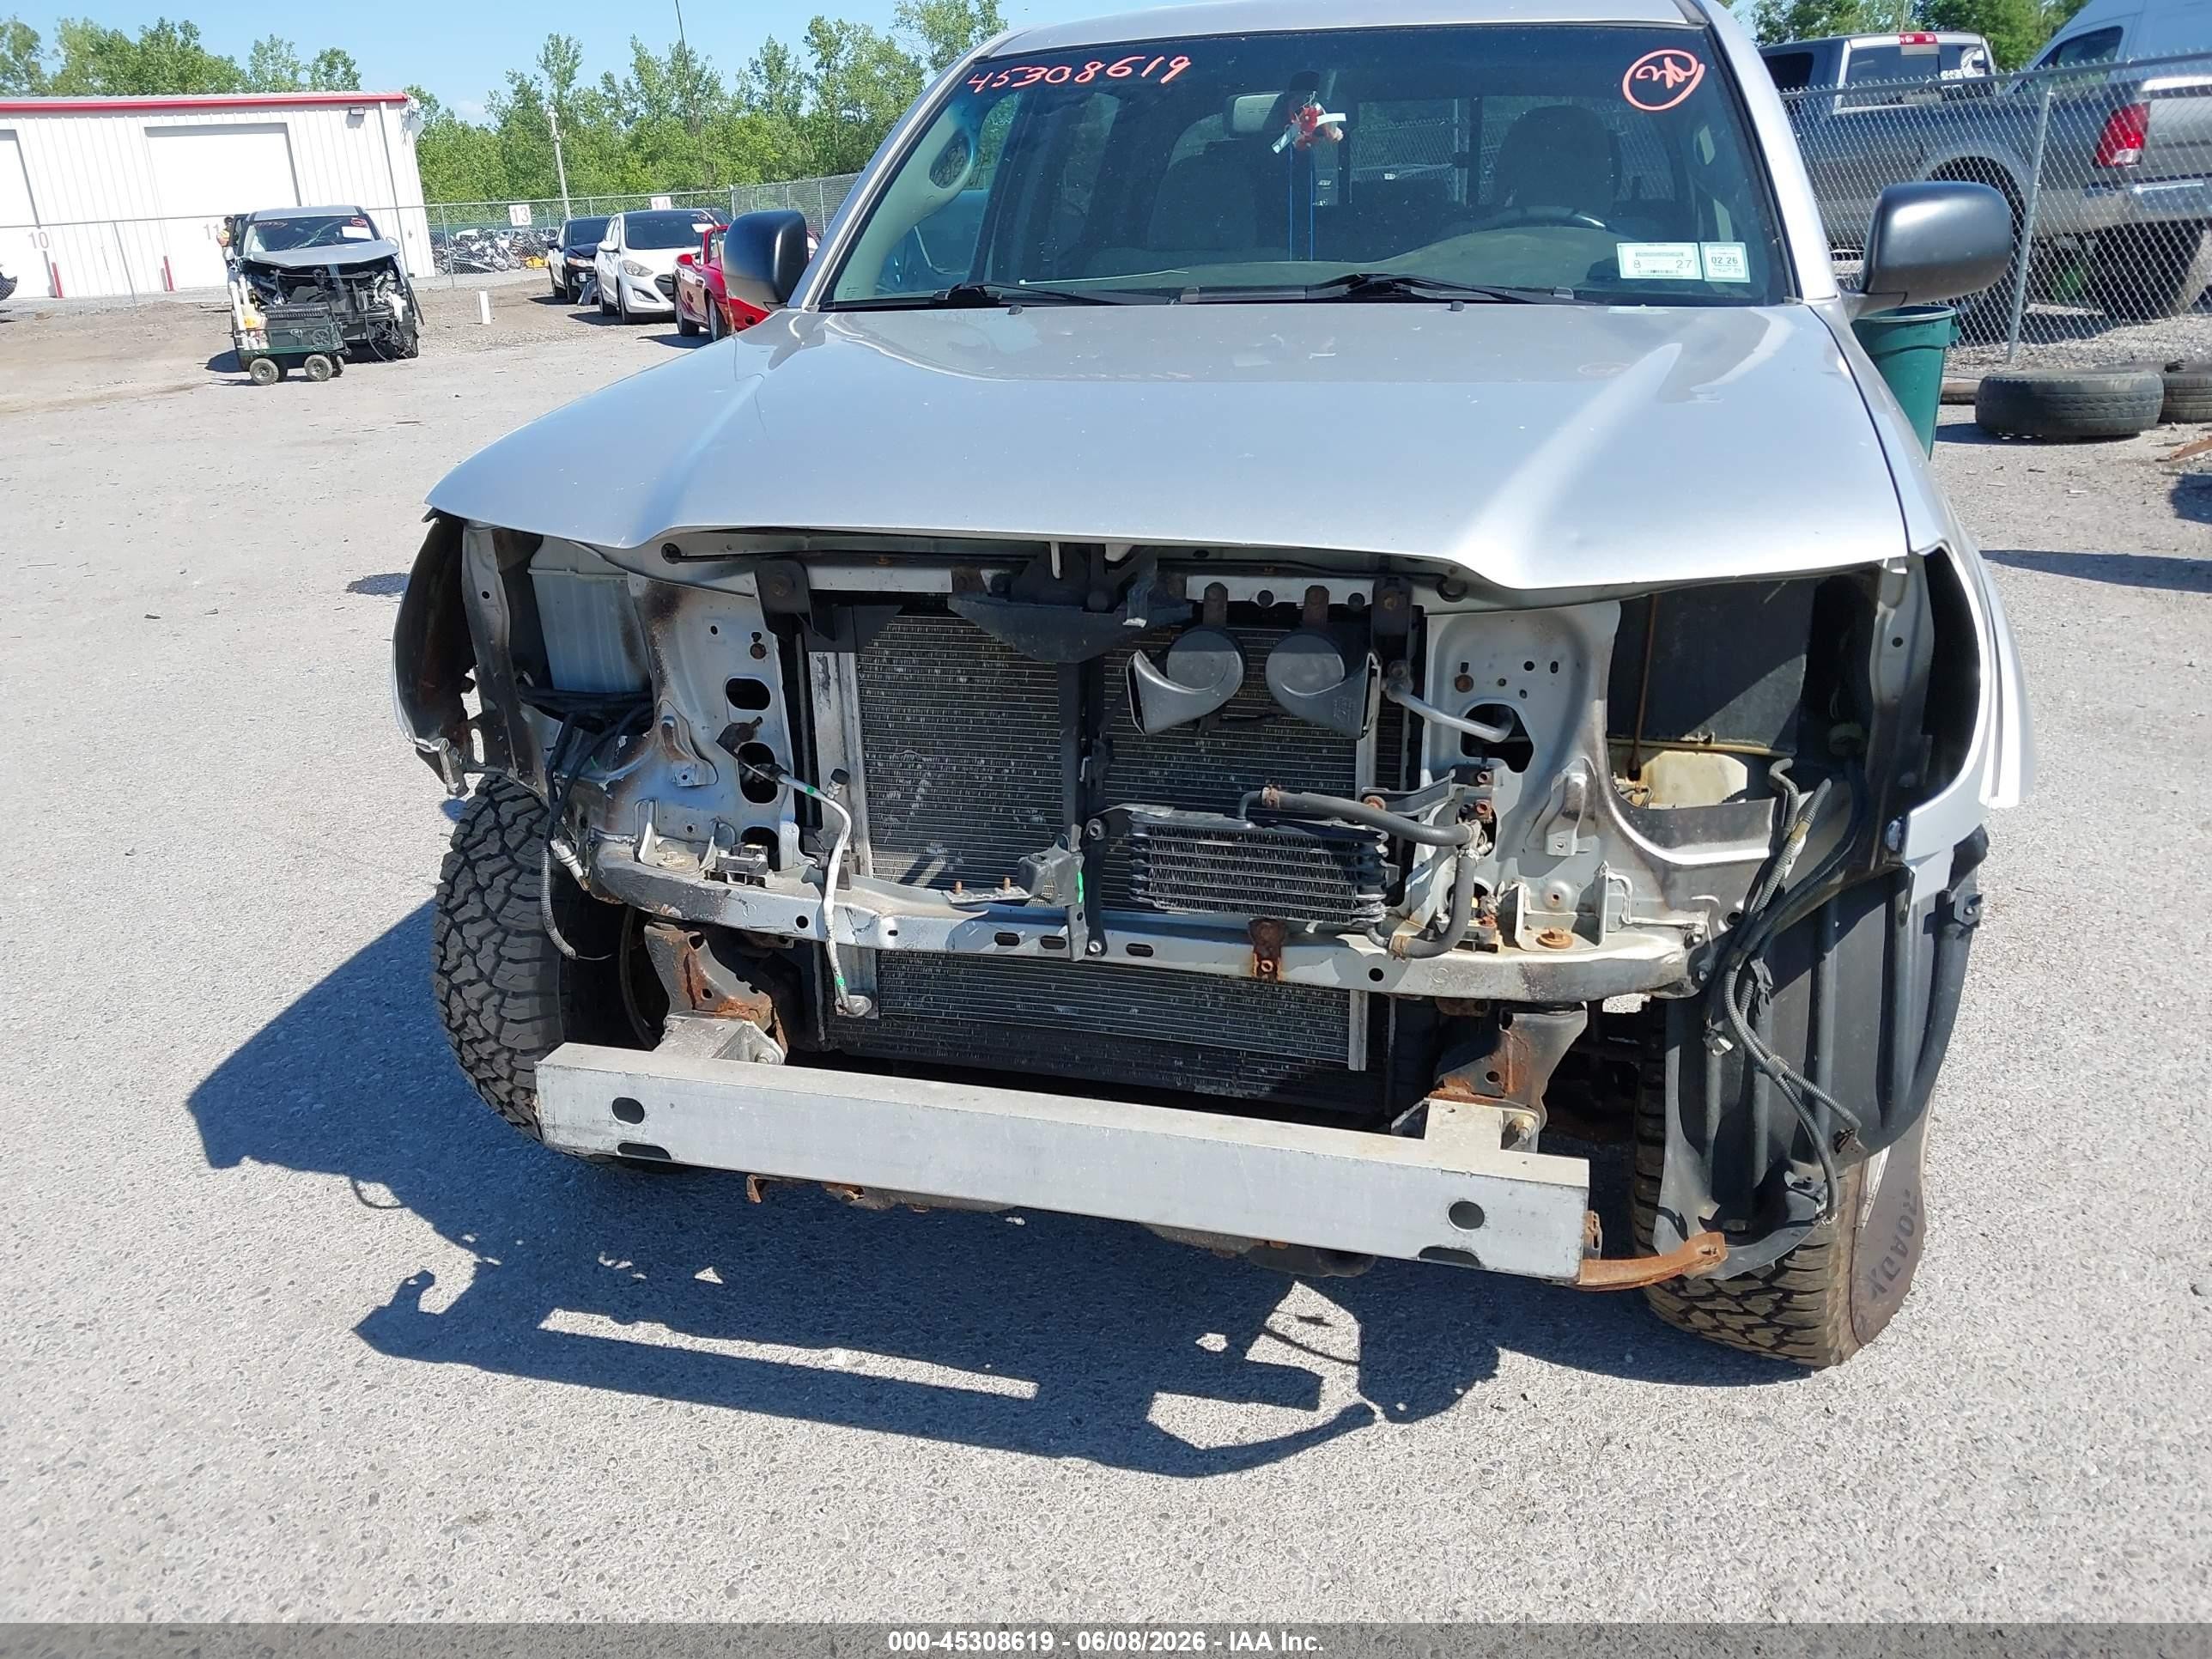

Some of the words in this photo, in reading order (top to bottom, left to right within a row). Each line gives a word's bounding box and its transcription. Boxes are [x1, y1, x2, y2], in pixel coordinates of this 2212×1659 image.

[966, 55, 1192, 94] 45308619
[511, 205, 530, 224] 13
[27, 231, 50, 249] 10
[1633, 259, 1641, 269] 8
[1675, 259, 1693, 270] 27
[1711, 256, 1723, 264] 02
[1727, 256, 1739, 264] 26
